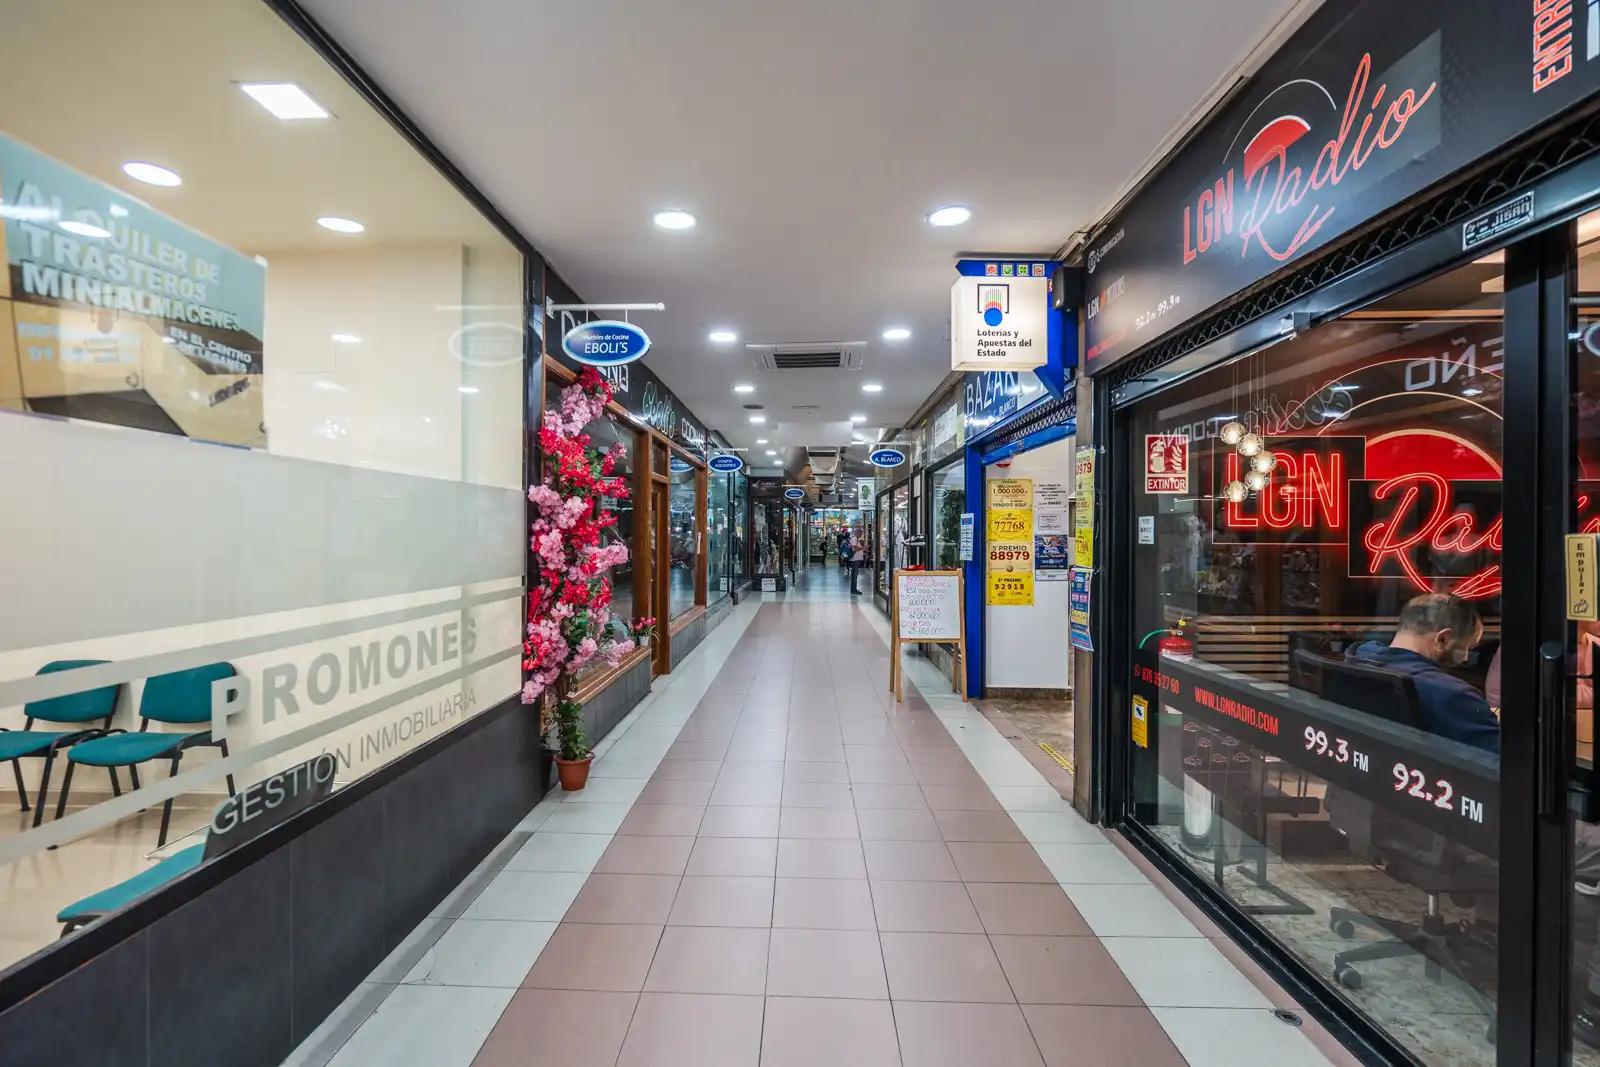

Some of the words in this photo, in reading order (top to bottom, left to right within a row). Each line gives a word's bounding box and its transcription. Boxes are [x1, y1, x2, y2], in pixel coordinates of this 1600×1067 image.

[1241, 53, 1436, 261] Radio
[1183, 168, 1234, 266] LGN
[18, 219, 207, 302] TRASTEROS
[193, 256, 220, 285] DE
[21, 259, 241, 332] MINIALMACENES
[977, 339, 1017, 349] Apuestas
[1019, 339, 1032, 347] del
[977, 349, 1006, 357] Estado
[1013, 331, 1019, 339] y
[1147, 478, 1186, 490] EXTINTOR
[1226, 452, 1341, 528] LGN
[994, 521, 1025, 531] 77768
[990, 551, 1030, 561] 88979
[211, 615, 477, 743] PROMONES
[1162, 674, 1170, 690] 27
[1195, 686, 1279, 736] WWW.LGNRADIO.COM
[210, 746, 351, 836] GESTIÓN
[360, 687, 477, 762] INMOBILIARIA
[1304, 726, 1349, 763] 99.3
[1353, 750, 1369, 773] FM
[1392, 762, 1454, 811] 92.2
[1461, 795, 1483, 824] FM
